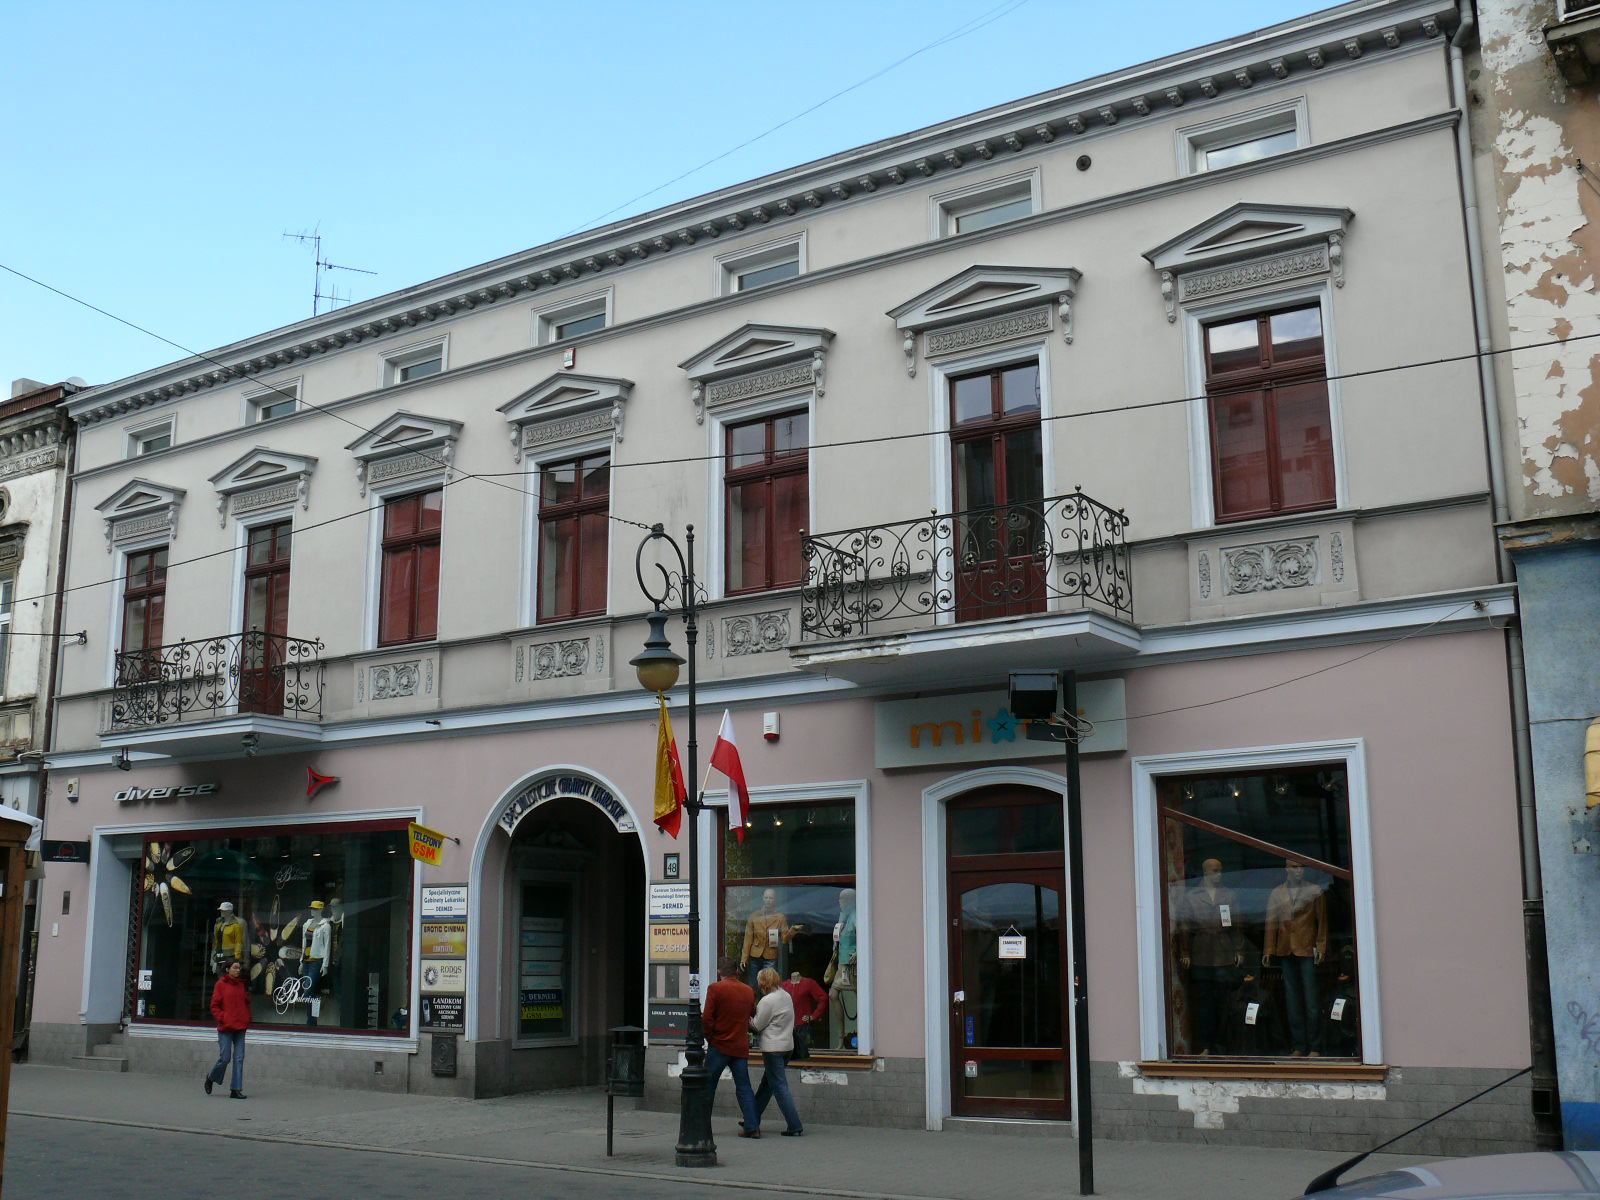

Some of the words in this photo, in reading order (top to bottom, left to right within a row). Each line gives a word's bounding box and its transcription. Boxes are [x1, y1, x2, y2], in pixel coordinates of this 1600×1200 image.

[113, 783, 217, 801] diverse
[413, 830, 442, 848] TELEFONY
[412, 841, 436, 860] GSM
[667, 862, 677, 873] 48
[423, 925, 443, 933] EROTIC
[443, 925, 465, 933] CINEMA
[653, 928, 689, 936] EROTICLAN
[655, 944, 668, 952] SEX
